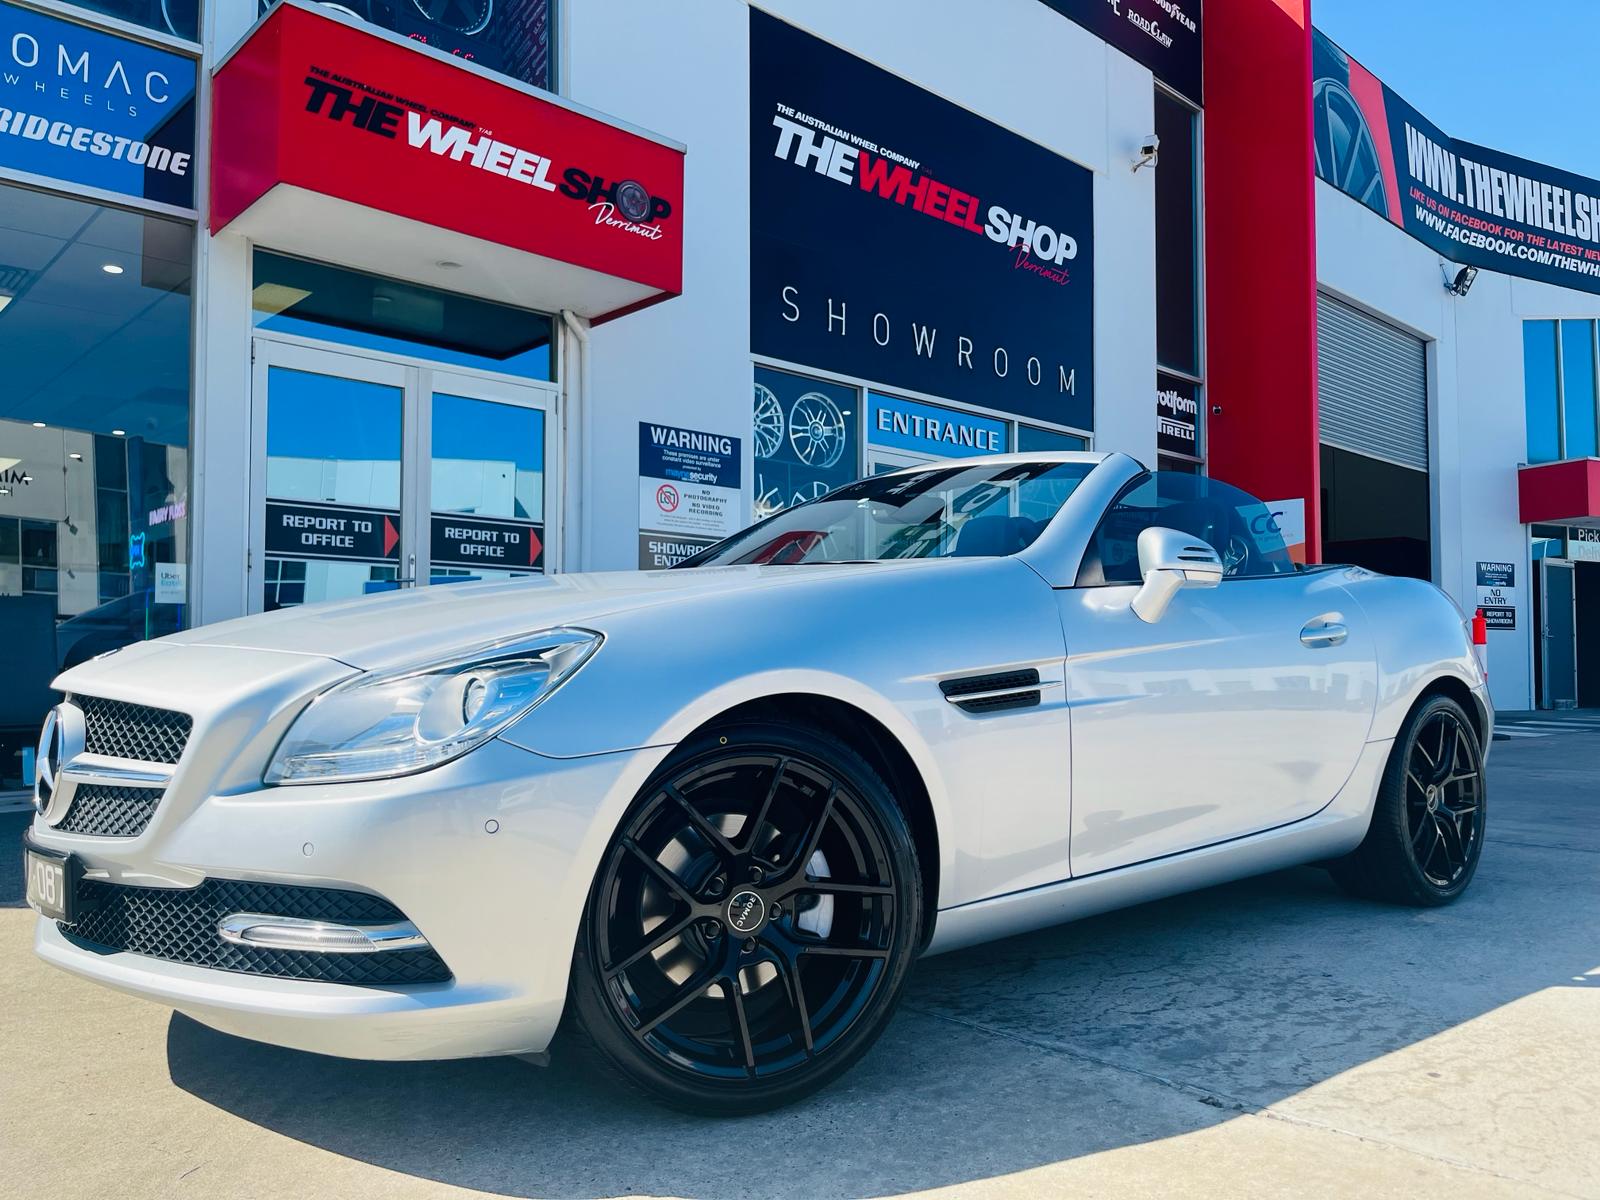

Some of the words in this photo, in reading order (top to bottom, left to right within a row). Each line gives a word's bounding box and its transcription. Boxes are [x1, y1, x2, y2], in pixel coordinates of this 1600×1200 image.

[1153, 0, 1196, 33] OODYEAR
[3, 72, 137, 117] WHEELS
[310, 65, 330, 78] THE
[331, 73, 394, 101] AUSTRALIAN
[395, 96, 429, 113] WHEEL
[430, 108, 477, 129] COMPANY
[304, 76, 405, 138] THE
[407, 110, 557, 193] WHEEL
[557, 166, 672, 223] SHOP
[776, 102, 796, 118] THE
[795, 111, 850, 141] AUSTRALIAN
[850, 133, 879, 154] WHEEL
[879, 147, 921, 170] COMPANY
[772, 115, 860, 186] THE
[858, 150, 985, 236] WHEEL
[984, 204, 1079, 266] SHOP
[587, 201, 663, 241] Derrimut
[1409, 186, 1426, 206] LIKE
[1426, 195, 1437, 212] US
[1438, 201, 1451, 219] ON
[1450, 210, 1503, 236] FACEBOOK
[1504, 227, 1524, 243] FOR
[1526, 233, 1546, 248] THE
[1546, 239, 1584, 258] LATEST
[1008, 243, 1071, 286] Derrimut
[781, 285, 1076, 397] SHOWROOM
[650, 426, 732, 456] WARNING
[876, 407, 1000, 452] ENTRANCE
[683, 493, 728, 504] PHOTOGRAPHY
[688, 508, 723, 517] RECORDING
[702, 503, 720, 511] VIDEO
[282, 514, 348, 532] REPORT
[351, 519, 372, 533] TO
[445, 527, 498, 543] REPORT
[502, 531, 520, 544] TO
[301, 532, 354, 548] OFFICE
[460, 543, 505, 558] OFFICE
[1480, 562, 1513, 573] WARNING
[1484, 596, 1507, 605] ENTRY
[1490, 588, 1501, 597] NO
[736, 895, 757, 927] ROMAC
